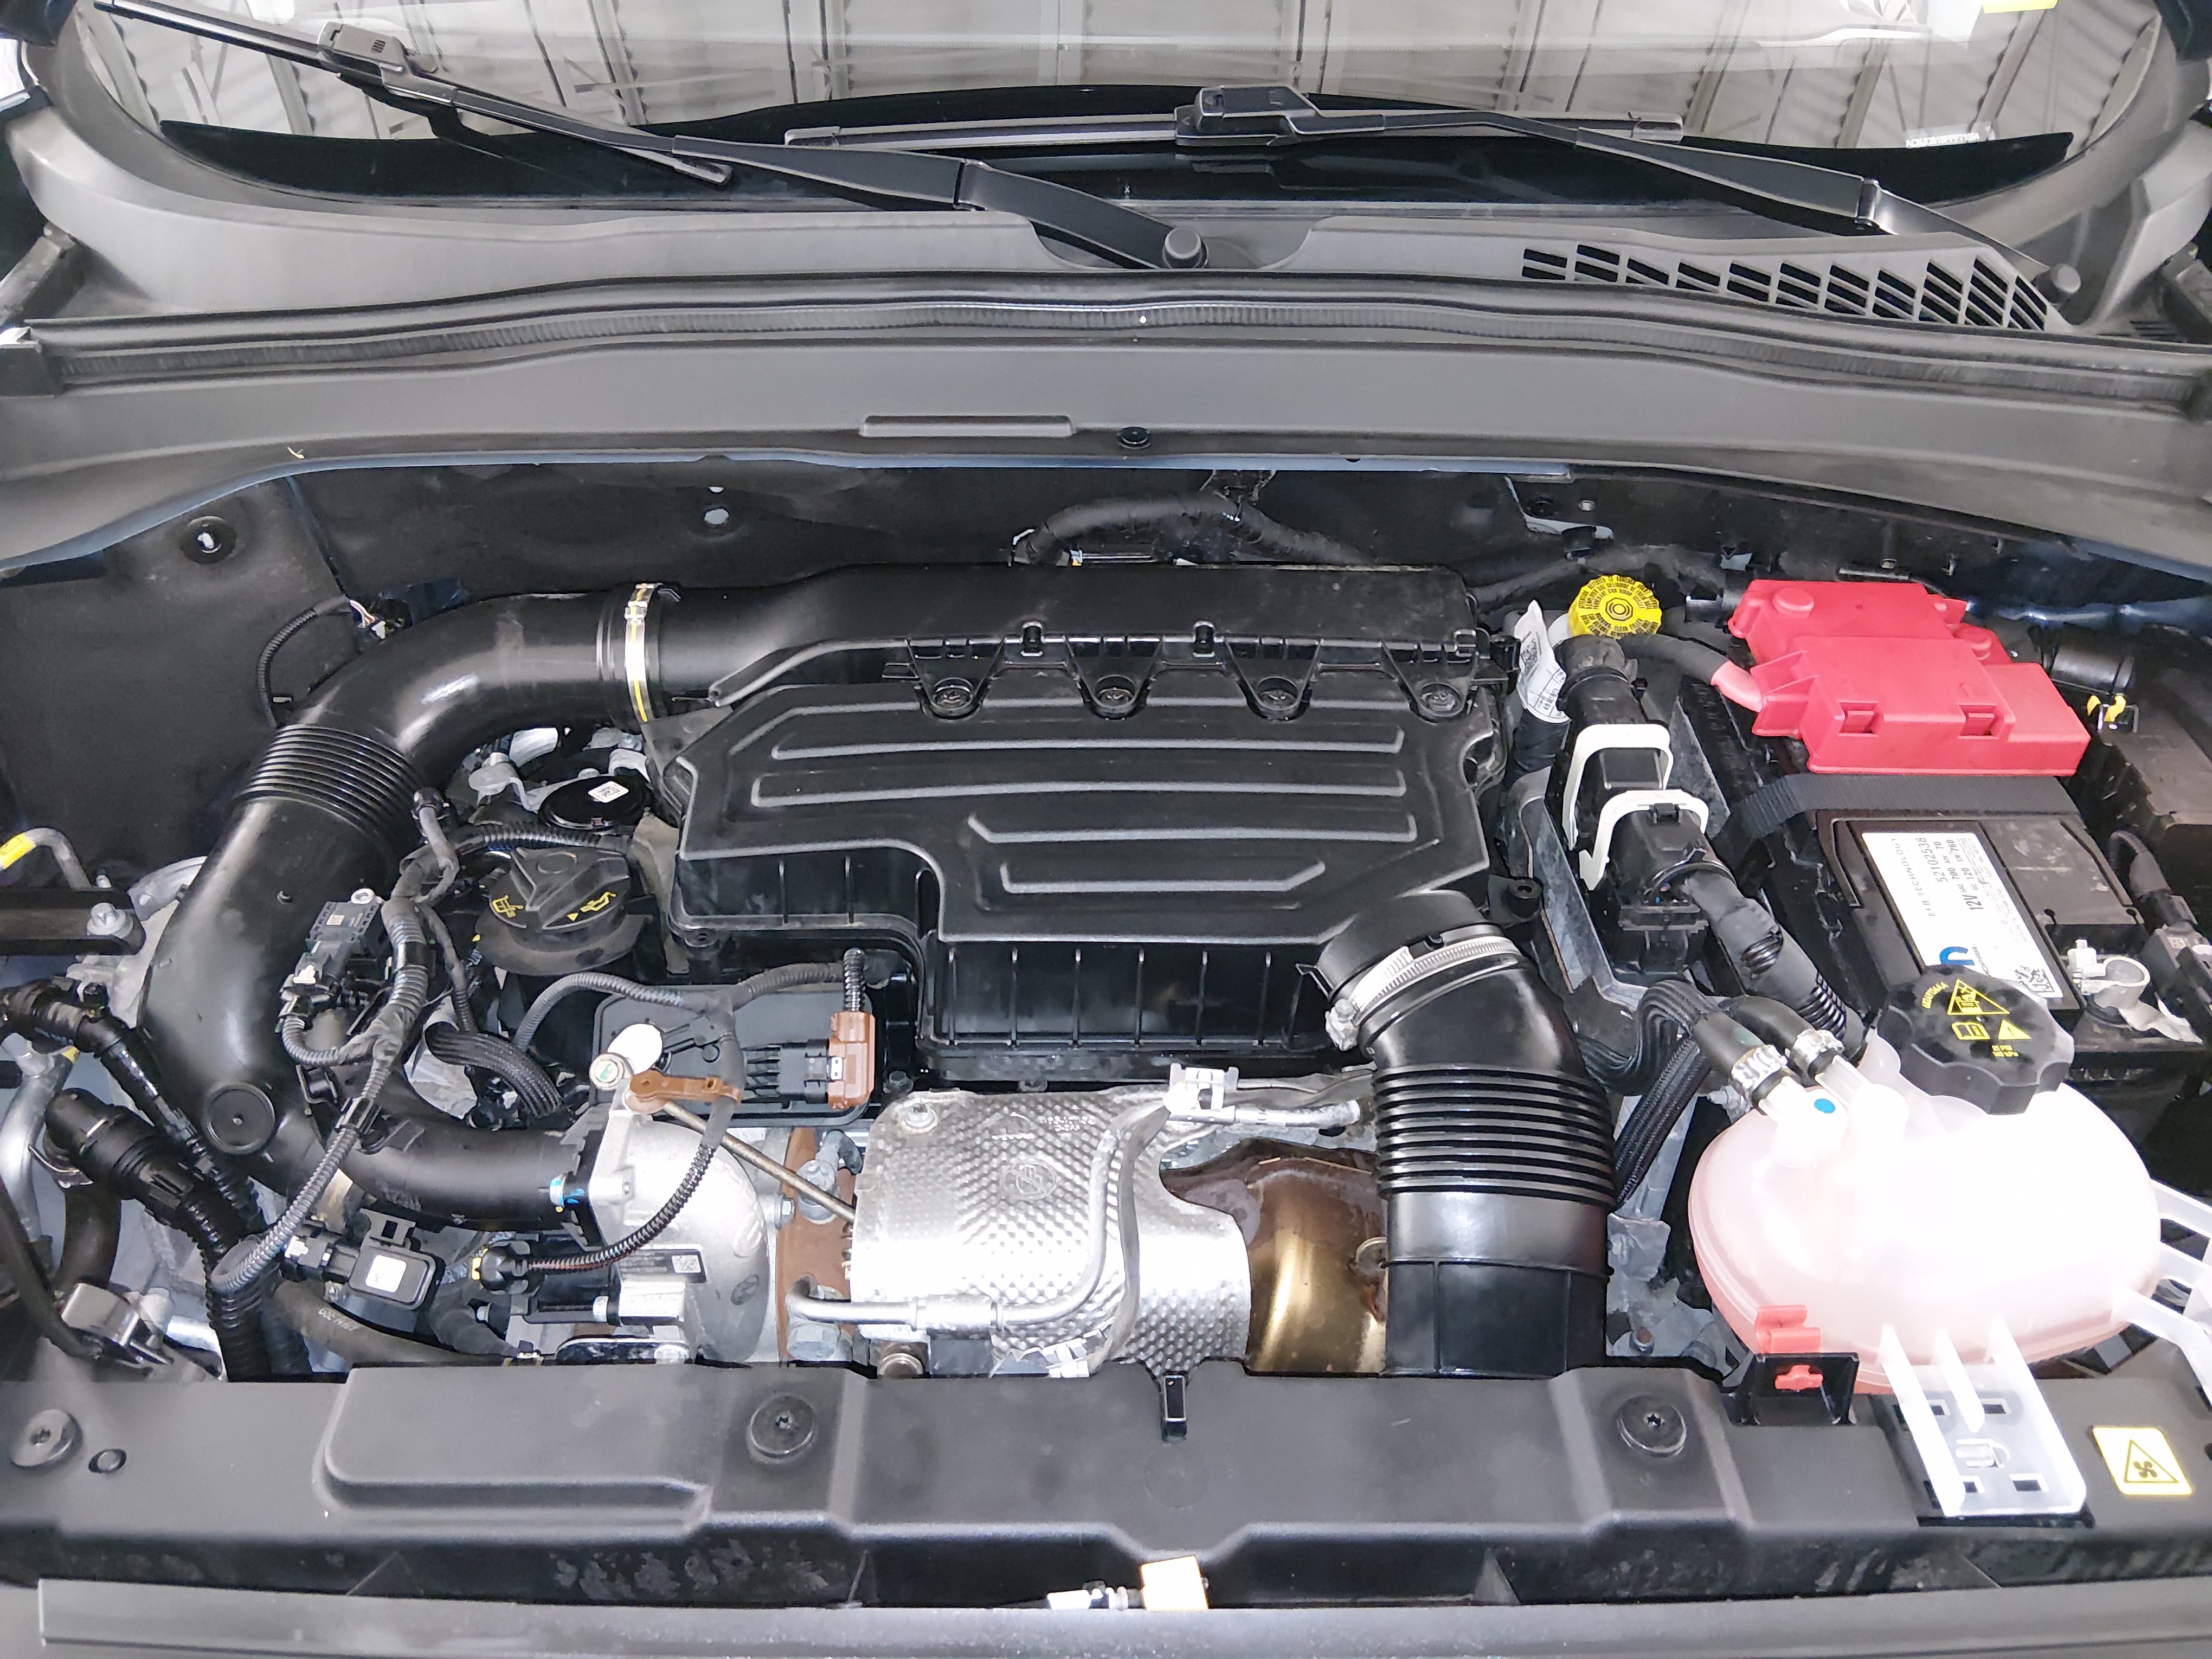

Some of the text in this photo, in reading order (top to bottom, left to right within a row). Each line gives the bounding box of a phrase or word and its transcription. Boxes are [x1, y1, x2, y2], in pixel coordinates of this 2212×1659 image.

[1933, 841, 1944, 850] 70
[1946, 839, 1959, 851] 760
[1915, 838, 1948, 882] 52102538
[1891, 838, 1935, 916] EFB TECHNOLOGY
[1947, 867, 1960, 879] 700
[1962, 867, 1975, 879] 120
[1962, 895, 1984, 910] 12V
